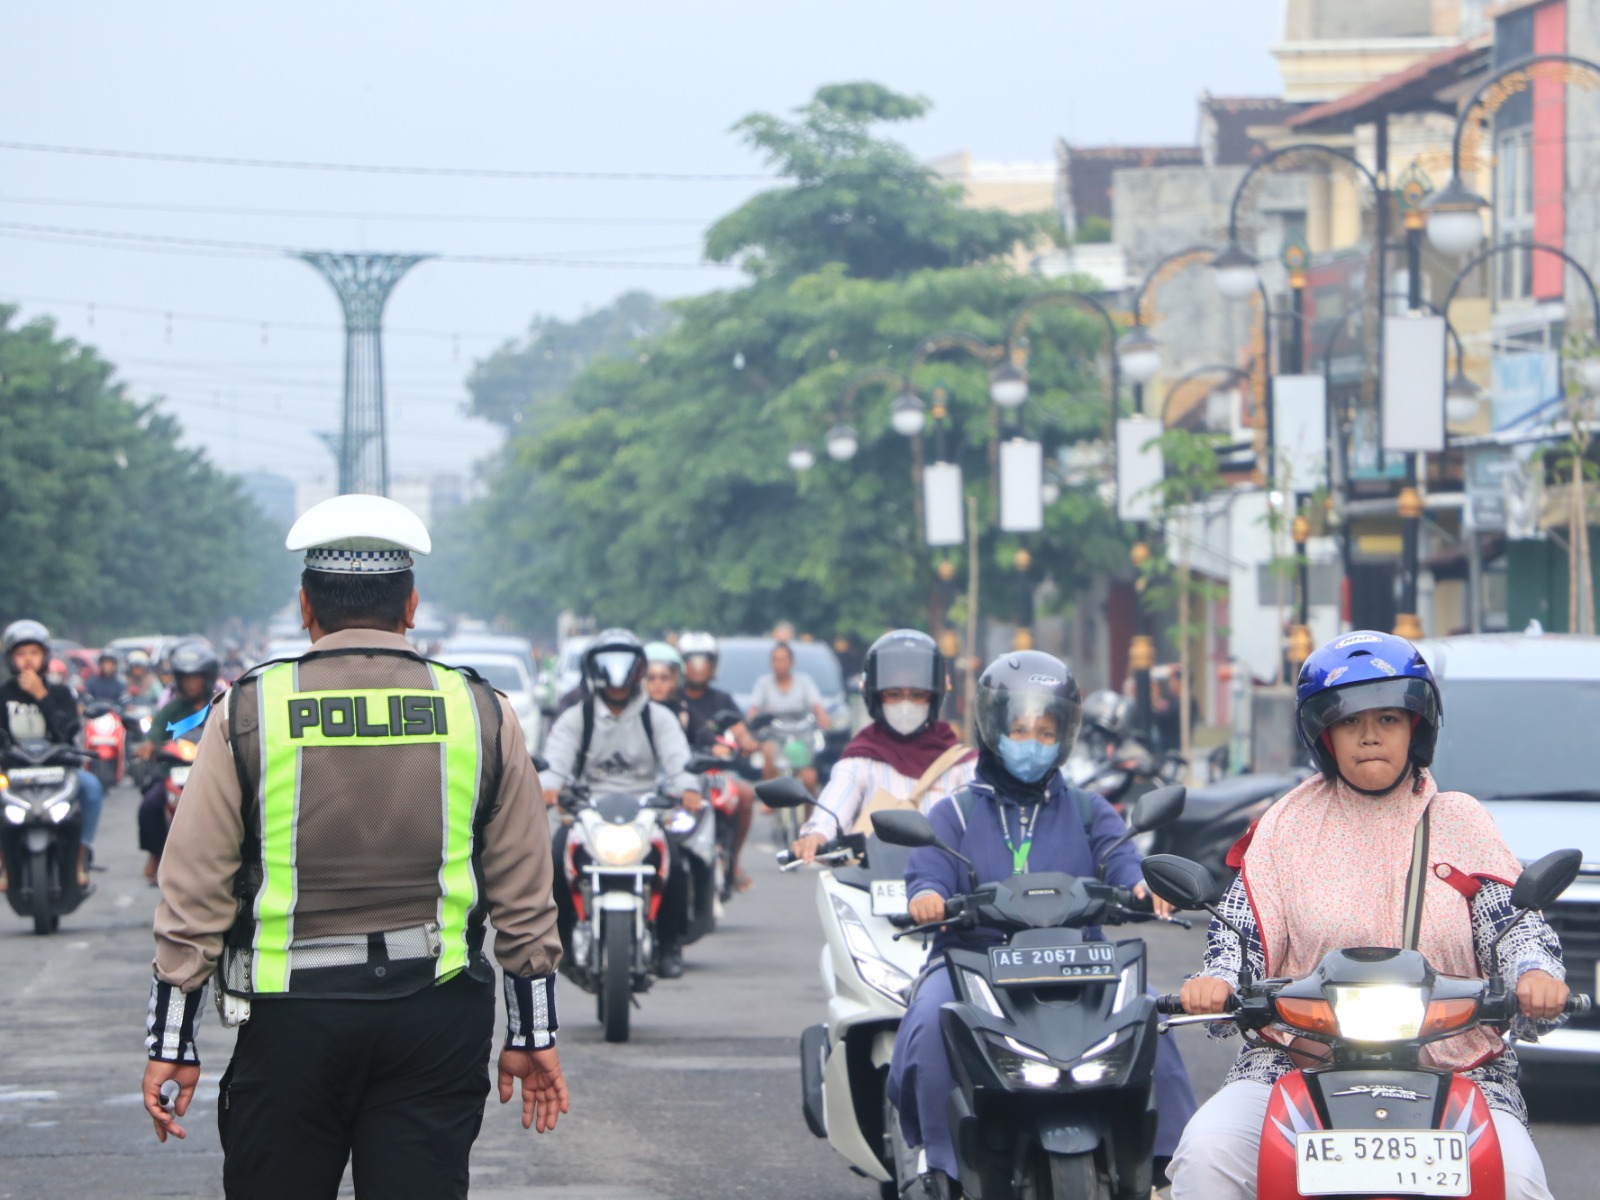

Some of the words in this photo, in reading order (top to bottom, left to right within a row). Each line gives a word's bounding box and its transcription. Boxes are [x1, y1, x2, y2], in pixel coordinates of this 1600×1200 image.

[287, 695, 448, 739] POLISI
[1000, 951, 1023, 966] AE
[1032, 949, 1077, 964] 2067
[1088, 947, 1112, 961] UU
[1381, 1091, 1417, 1100] HONDA
[1305, 1138, 1335, 1161] AE
[1354, 1137, 1417, 1160] 5285
[1433, 1138, 1463, 1161] TD
